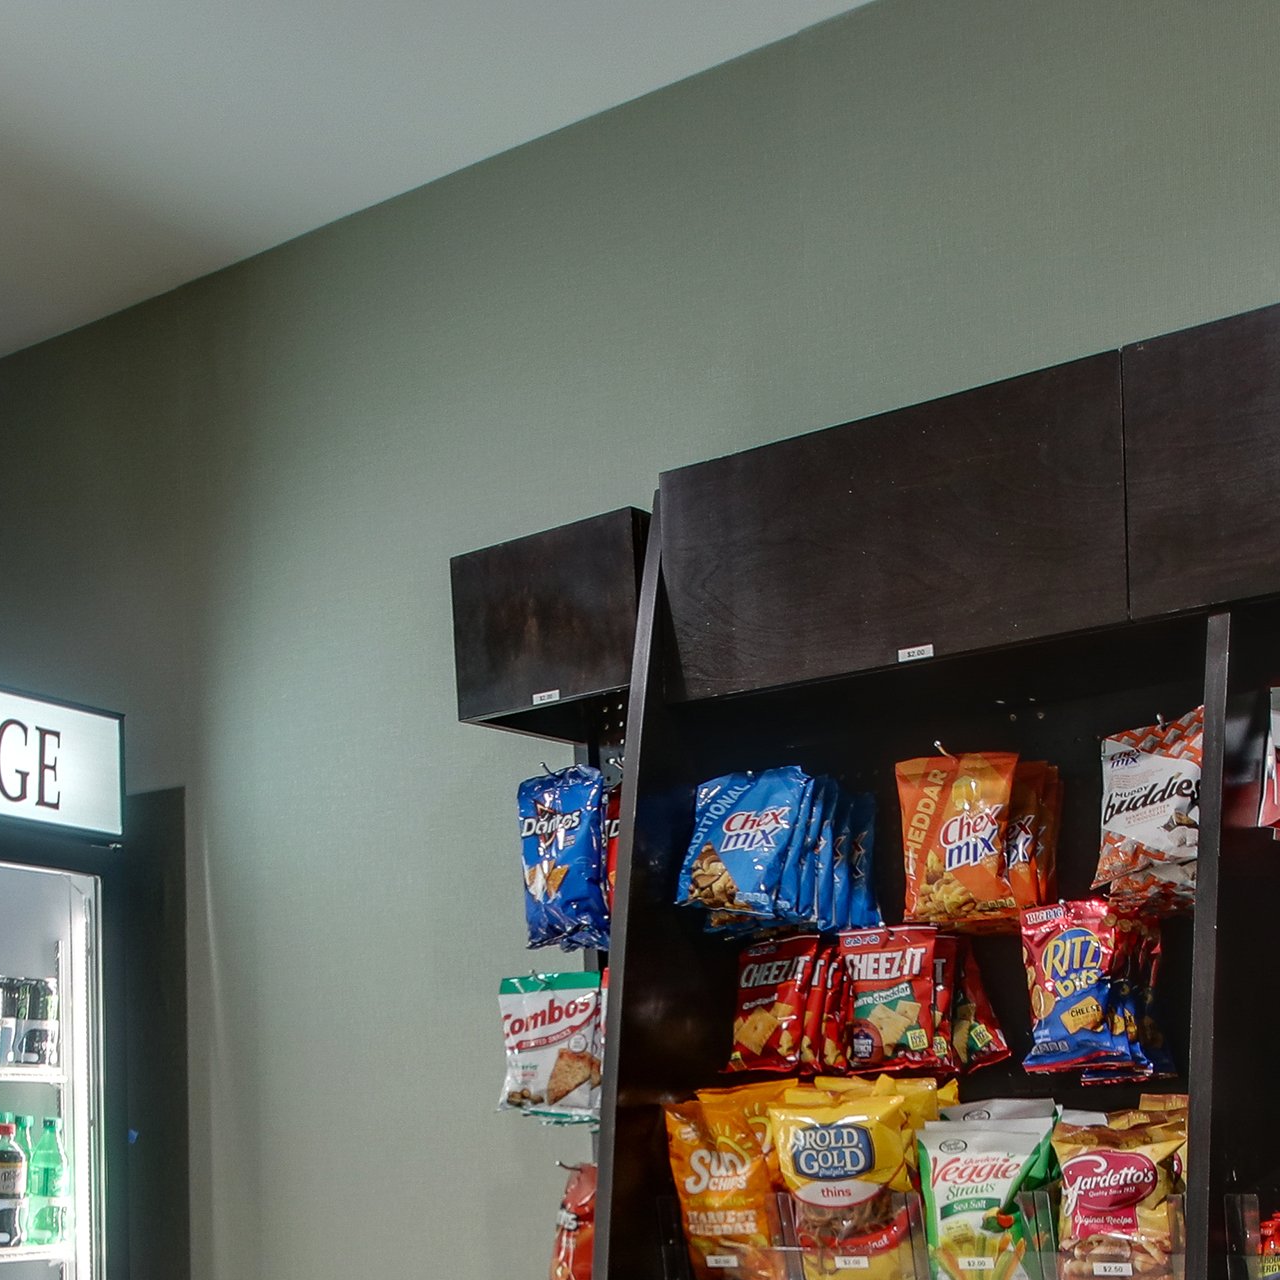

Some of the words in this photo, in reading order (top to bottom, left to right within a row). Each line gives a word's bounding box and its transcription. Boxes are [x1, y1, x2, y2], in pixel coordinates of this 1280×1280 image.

[1103, 771, 1202, 825] buddies
[1114, 783, 1150, 799] MUDDY
[521, 809, 581, 838] Doritos
[722, 806, 793, 837] Chex
[939, 804, 1004, 846] Chex
[720, 825, 782, 852] mix
[944, 837, 997, 871] mix
[1025, 910, 1043, 925] BIG
[1042, 906, 1065, 922] BAG
[1045, 933, 1102, 974] RITZ
[1056, 968, 1099, 998] bits
[501, 998, 591, 1040] Combos
[1070, 1003, 1101, 1019] CHEESE
[803, 1128, 864, 1149] ROLD
[685, 1149, 751, 1195] Sun
[798, 1147, 866, 1175] GOLD
[931, 1155, 1021, 1189] Veggie
[709, 1173, 748, 1192] CHIPS
[820, 1186, 852, 1199] thins
[1061, 1153, 1156, 1216] Gardetto's
[687, 1209, 758, 1222] HARVEST
[952, 1201, 969, 1211] Sea
[969, 1198, 987, 1210] Salt
[687, 1222, 758, 1235] CHEDDAR
[1105, 1215, 1133, 1225] Recipe
[1102, 1265, 1123, 1273] $2.50
